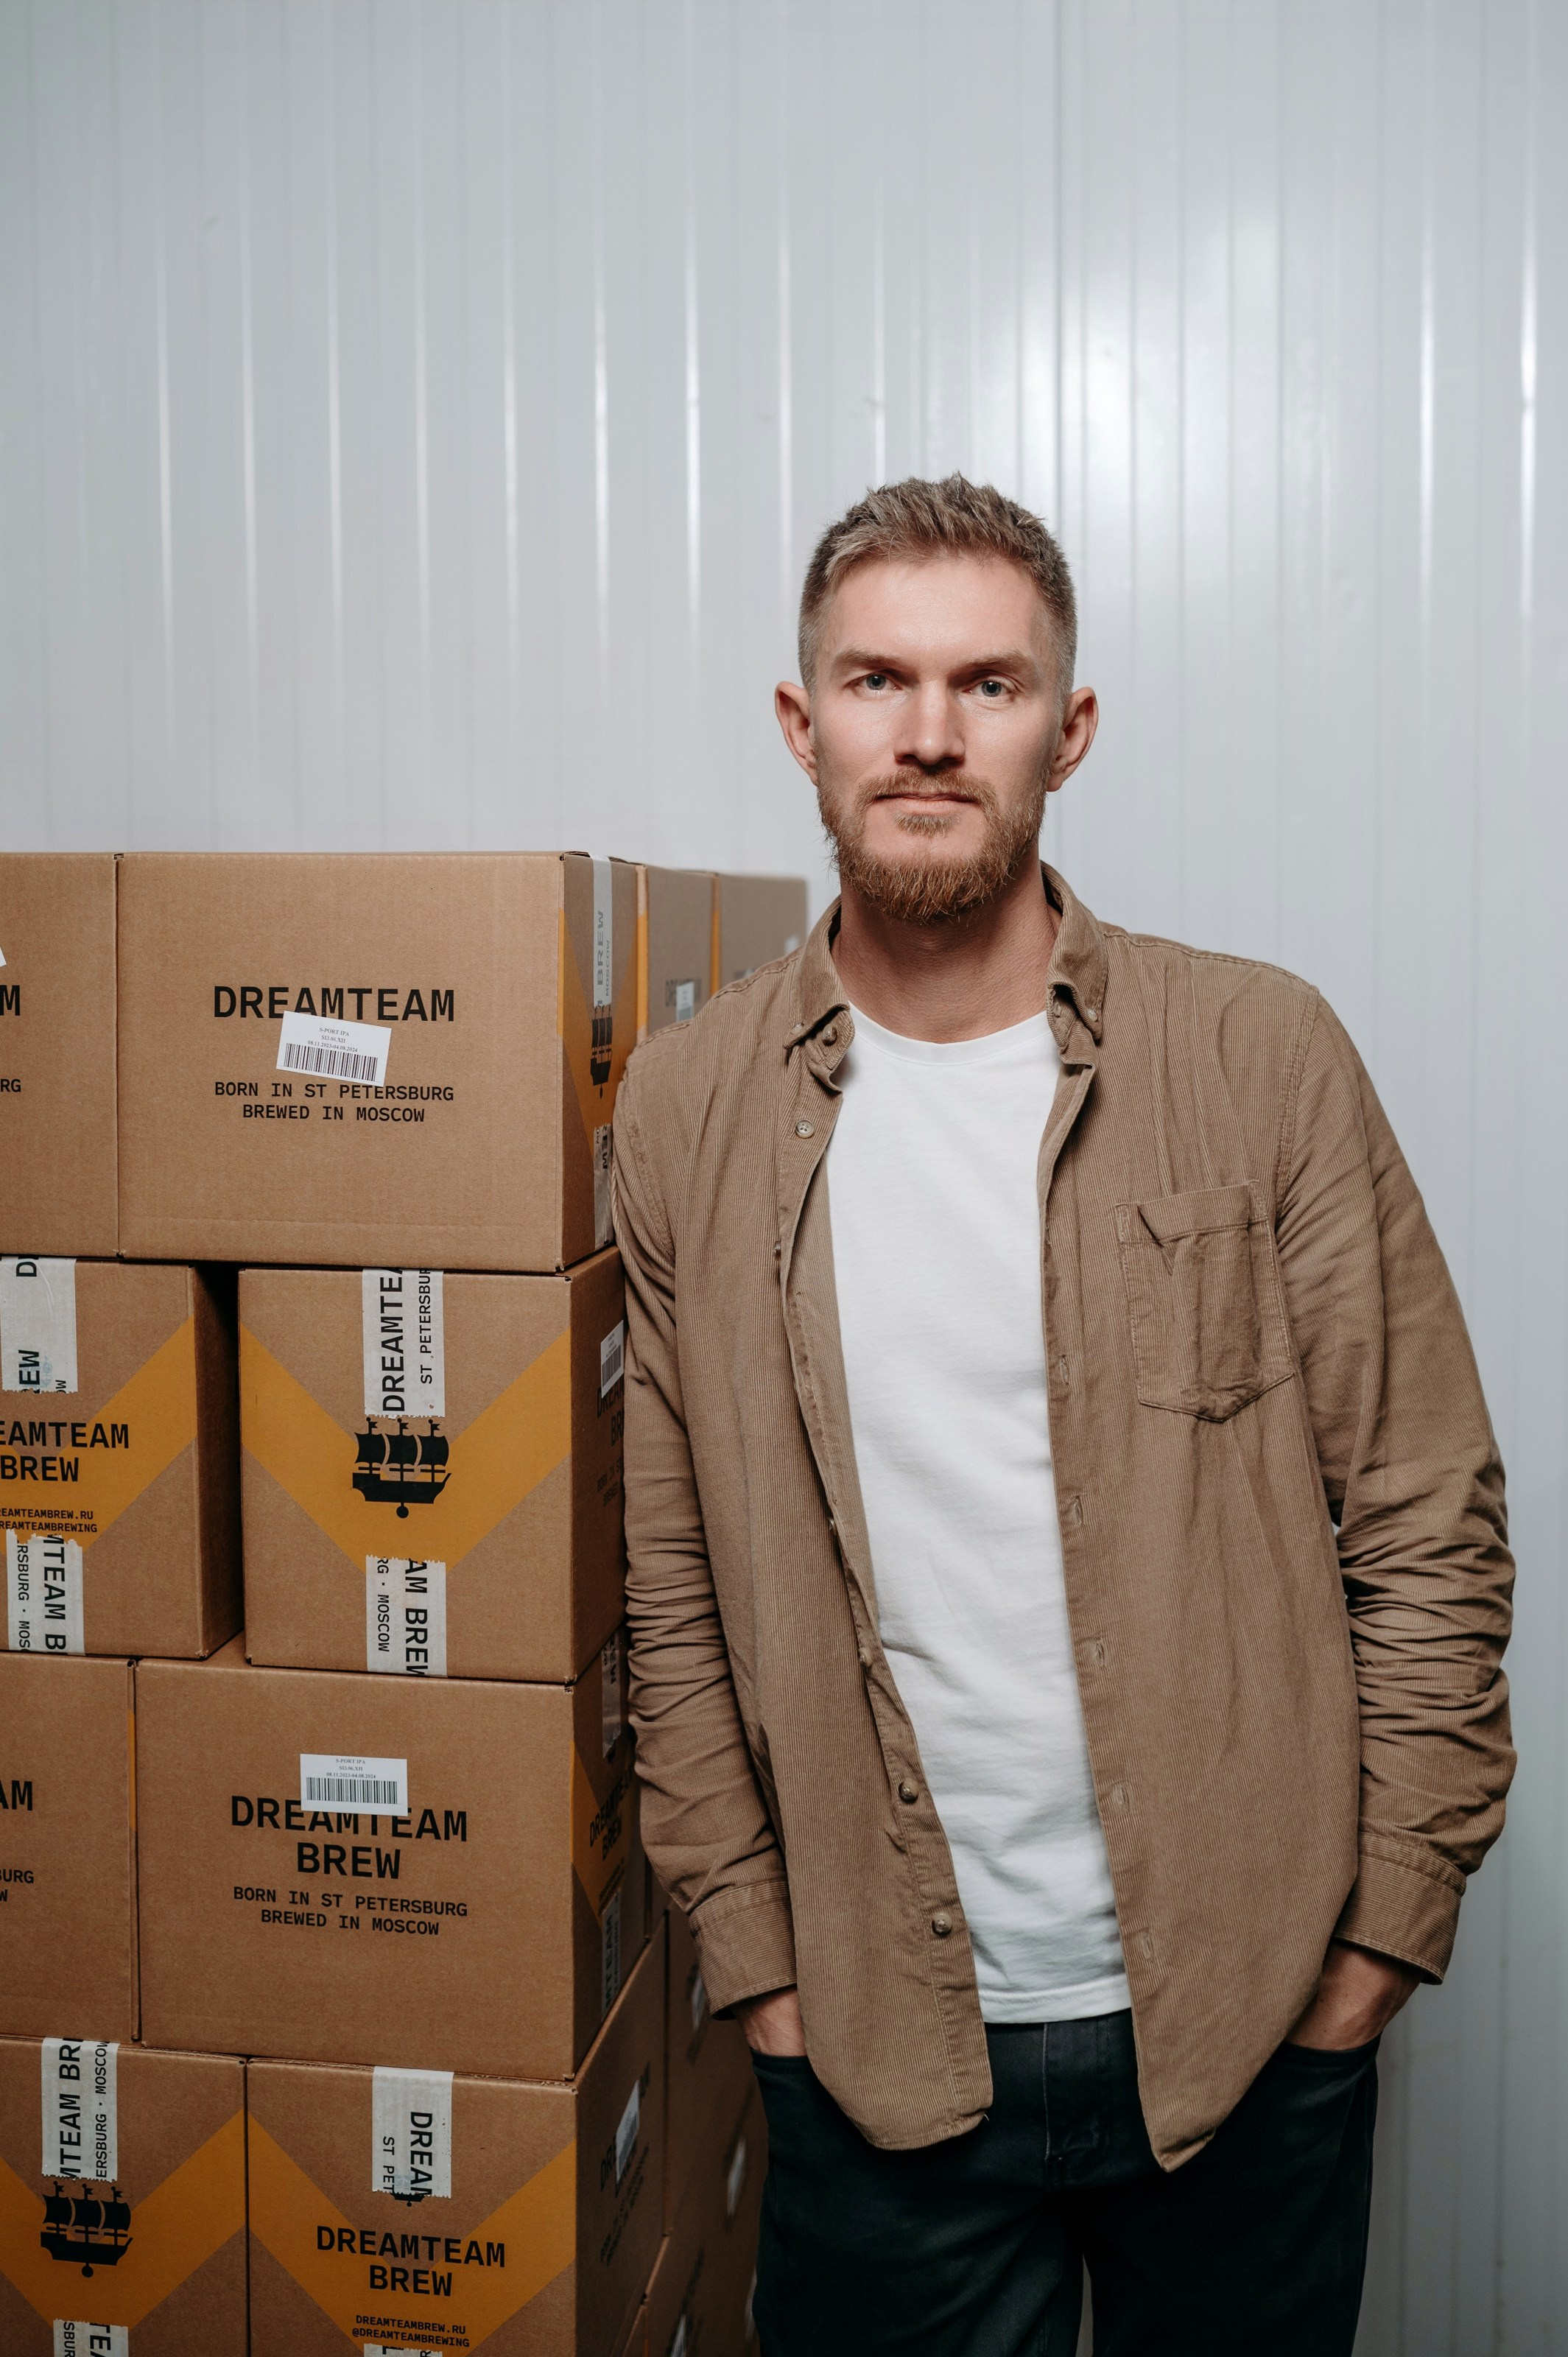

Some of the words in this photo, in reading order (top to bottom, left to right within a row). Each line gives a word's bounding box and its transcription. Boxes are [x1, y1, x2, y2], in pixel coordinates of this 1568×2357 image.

[214, 986, 454, 1022] DREAMTEAM
[319, 1027, 339, 1035] S-PORT
[340, 1029, 350, 1037] IPA
[307, 1040, 358, 1053] 08.11.2023-04.08.2024
[215, 1081, 259, 1097] BORN
[271, 1083, 292, 1097] IN
[304, 1083, 327, 1098] ST
[340, 1084, 454, 1101] PETERSBURG
[242, 1104, 309, 1120] BREWED
[323, 1106, 343, 1120] IN
[356, 1106, 425, 1122] MOSCOW
[421, 1365, 432, 1385] ST
[0, 1455, 79, 1482] BREW
[0, 1508, 94, 1520] EAMTEAMBREW.RU
[17, 1542, 29, 1601] RSBURG
[18, 1620, 30, 1651] MOS
[377, 1594, 390, 1652] MOSCOW
[297, 1842, 401, 1879] BREW
[233, 1886, 276, 1903] BORN
[289, 1890, 309, 1905] IN
[321, 1893, 343, 1908] ST
[355, 1896, 468, 1917] PETERSBURG
[261, 1908, 326, 1928] BREWED
[339, 1915, 359, 1930] IN
[372, 1917, 440, 1936] MOSCOW
[59, 2038, 83, 2081] BR
[382, 2136, 395, 2156] ST
[317, 2225, 505, 2268] DREAMTEAM
[369, 2264, 452, 2297] BREW
[351, 2328, 470, 2347] @DREAMTEAMBREWING
[355, 2314, 466, 2335] DREAMTEAMBREW.RU
